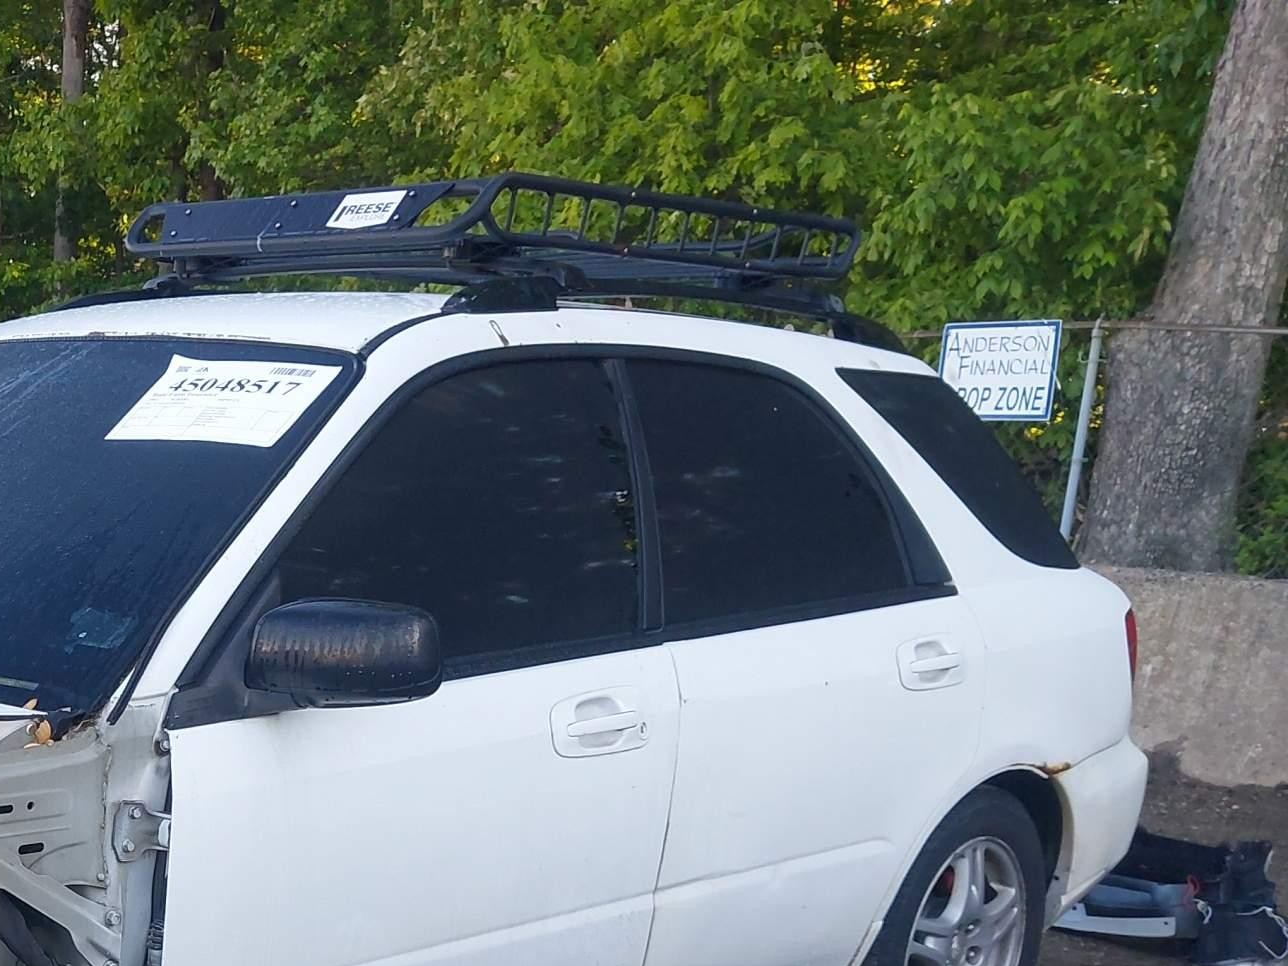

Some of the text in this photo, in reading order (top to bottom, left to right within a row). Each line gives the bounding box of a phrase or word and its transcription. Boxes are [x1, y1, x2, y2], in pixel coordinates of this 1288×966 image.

[344, 202, 395, 216] REESE
[949, 332, 1050, 357] ANDERSON
[959, 355, 1049, 379] FINANCIAL
[169, 377, 302, 396] 45048517
[994, 386, 1045, 411] ZONE
